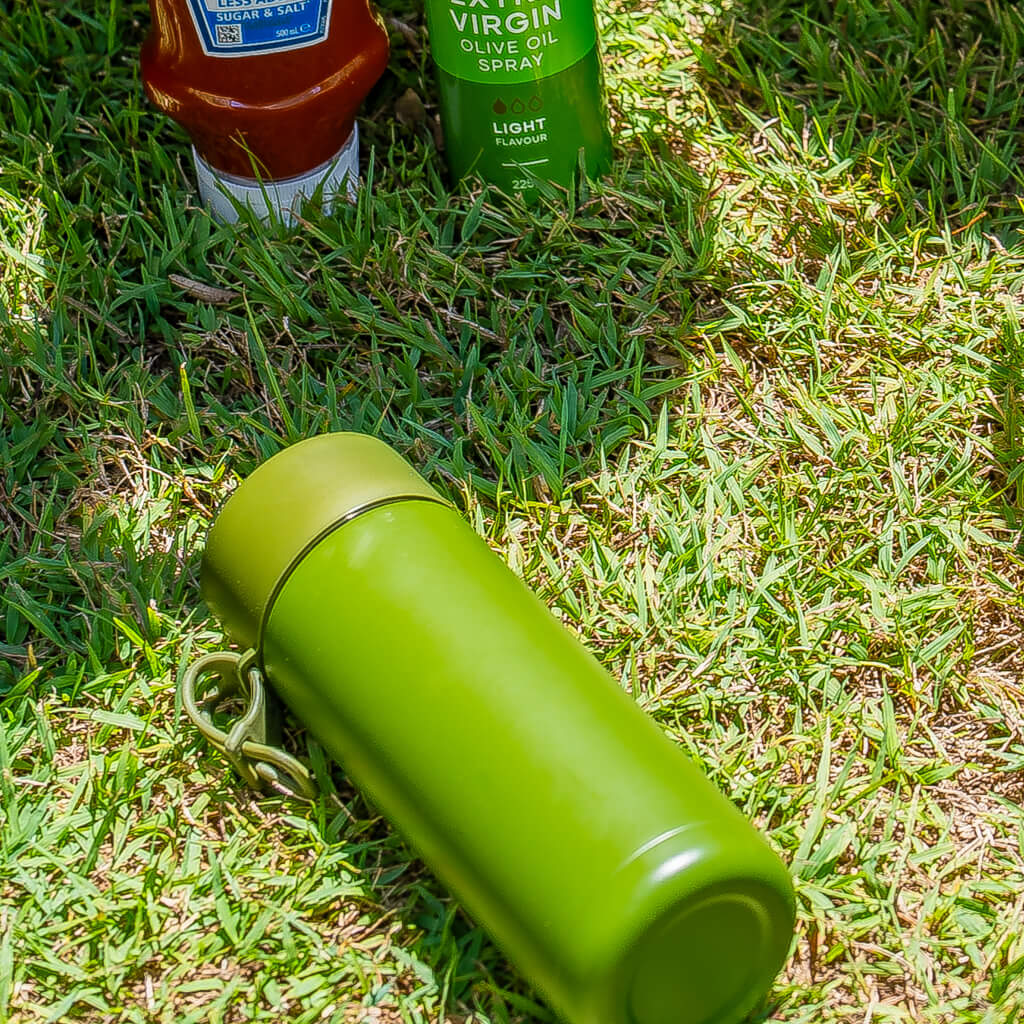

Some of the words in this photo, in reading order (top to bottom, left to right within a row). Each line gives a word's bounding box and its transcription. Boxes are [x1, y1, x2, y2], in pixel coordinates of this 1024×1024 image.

[216, 11, 260, 22] SUGAR
[263, 8, 273, 18] &
[449, 0, 562, 36] VIRGIN
[460, 38, 519, 55] OLIVE
[526, 31, 559, 51] OIL
[478, 52, 544, 72] SPRAY
[492, 118, 547, 134] LIGHT
[495, 133, 548, 147] FLAVOUR
